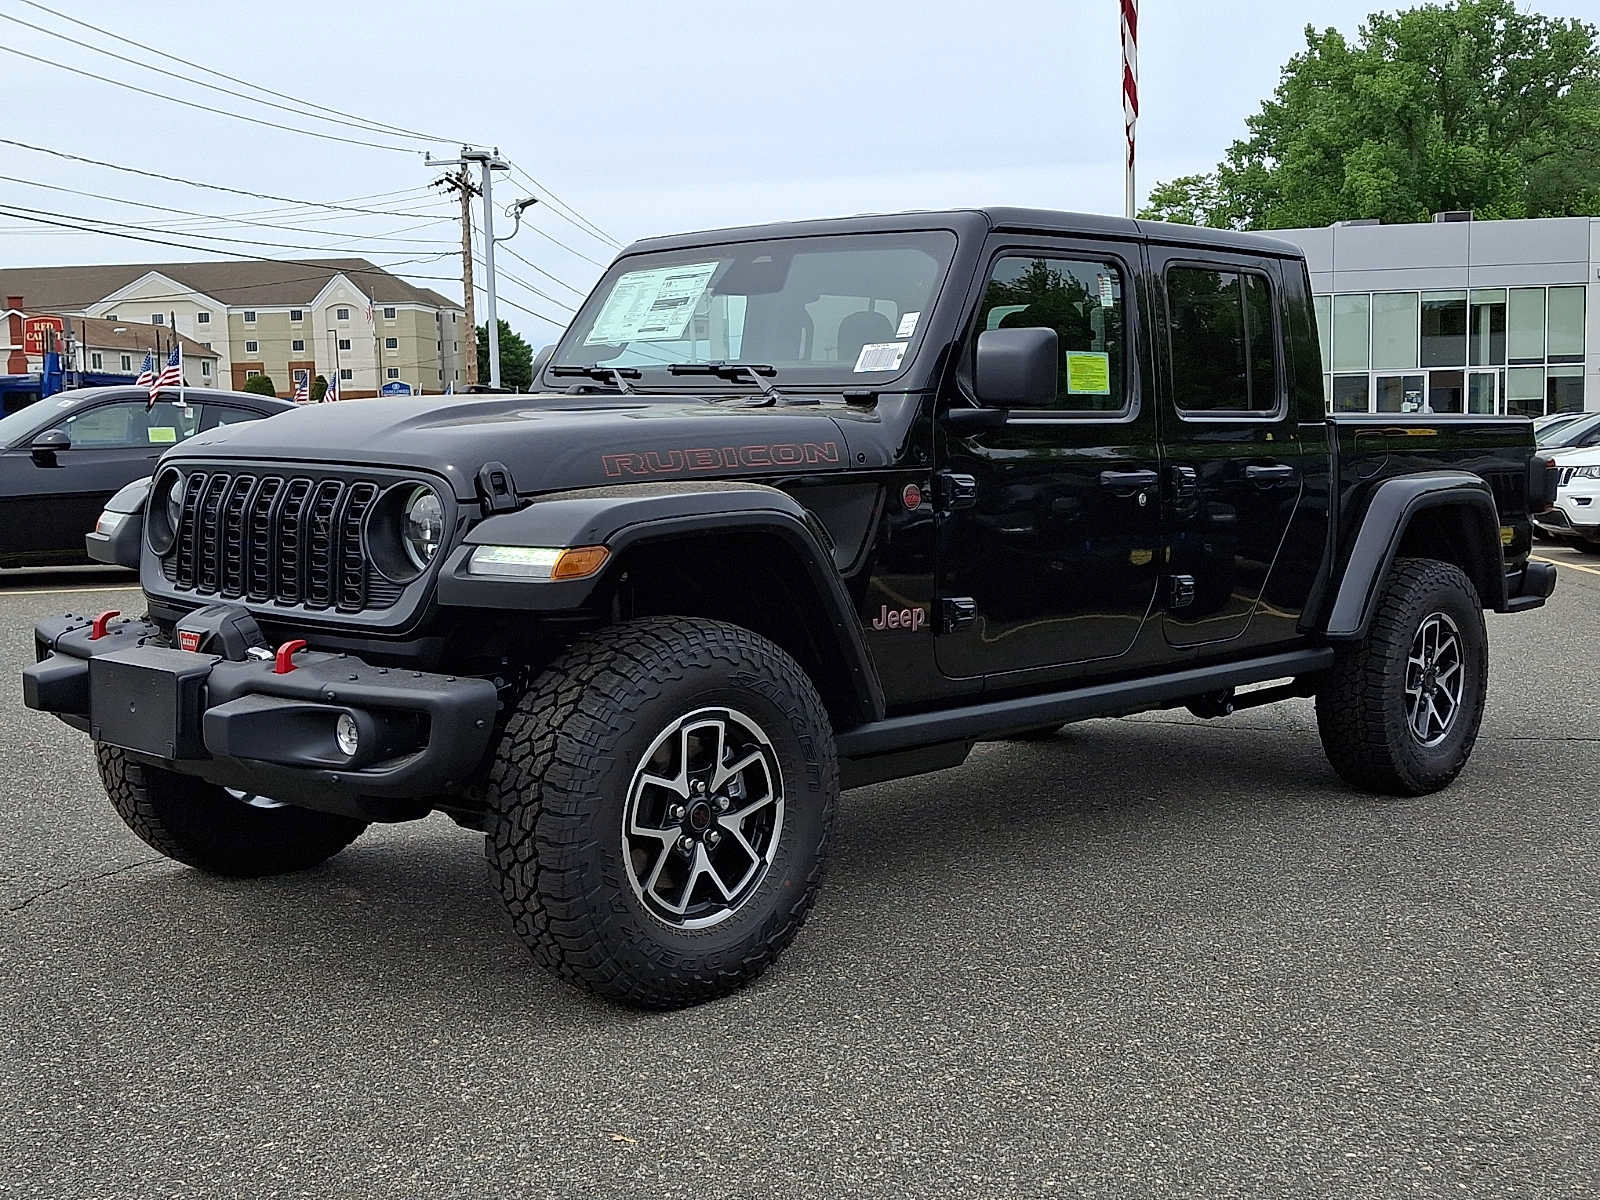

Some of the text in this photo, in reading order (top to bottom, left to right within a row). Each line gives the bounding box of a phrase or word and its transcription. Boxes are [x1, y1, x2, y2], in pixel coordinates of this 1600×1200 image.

[33, 322, 54, 331] RED
[602, 441, 840, 477] RUBICON
[872, 604, 925, 632] Jeep
[728, 671, 820, 793] FALKEN
